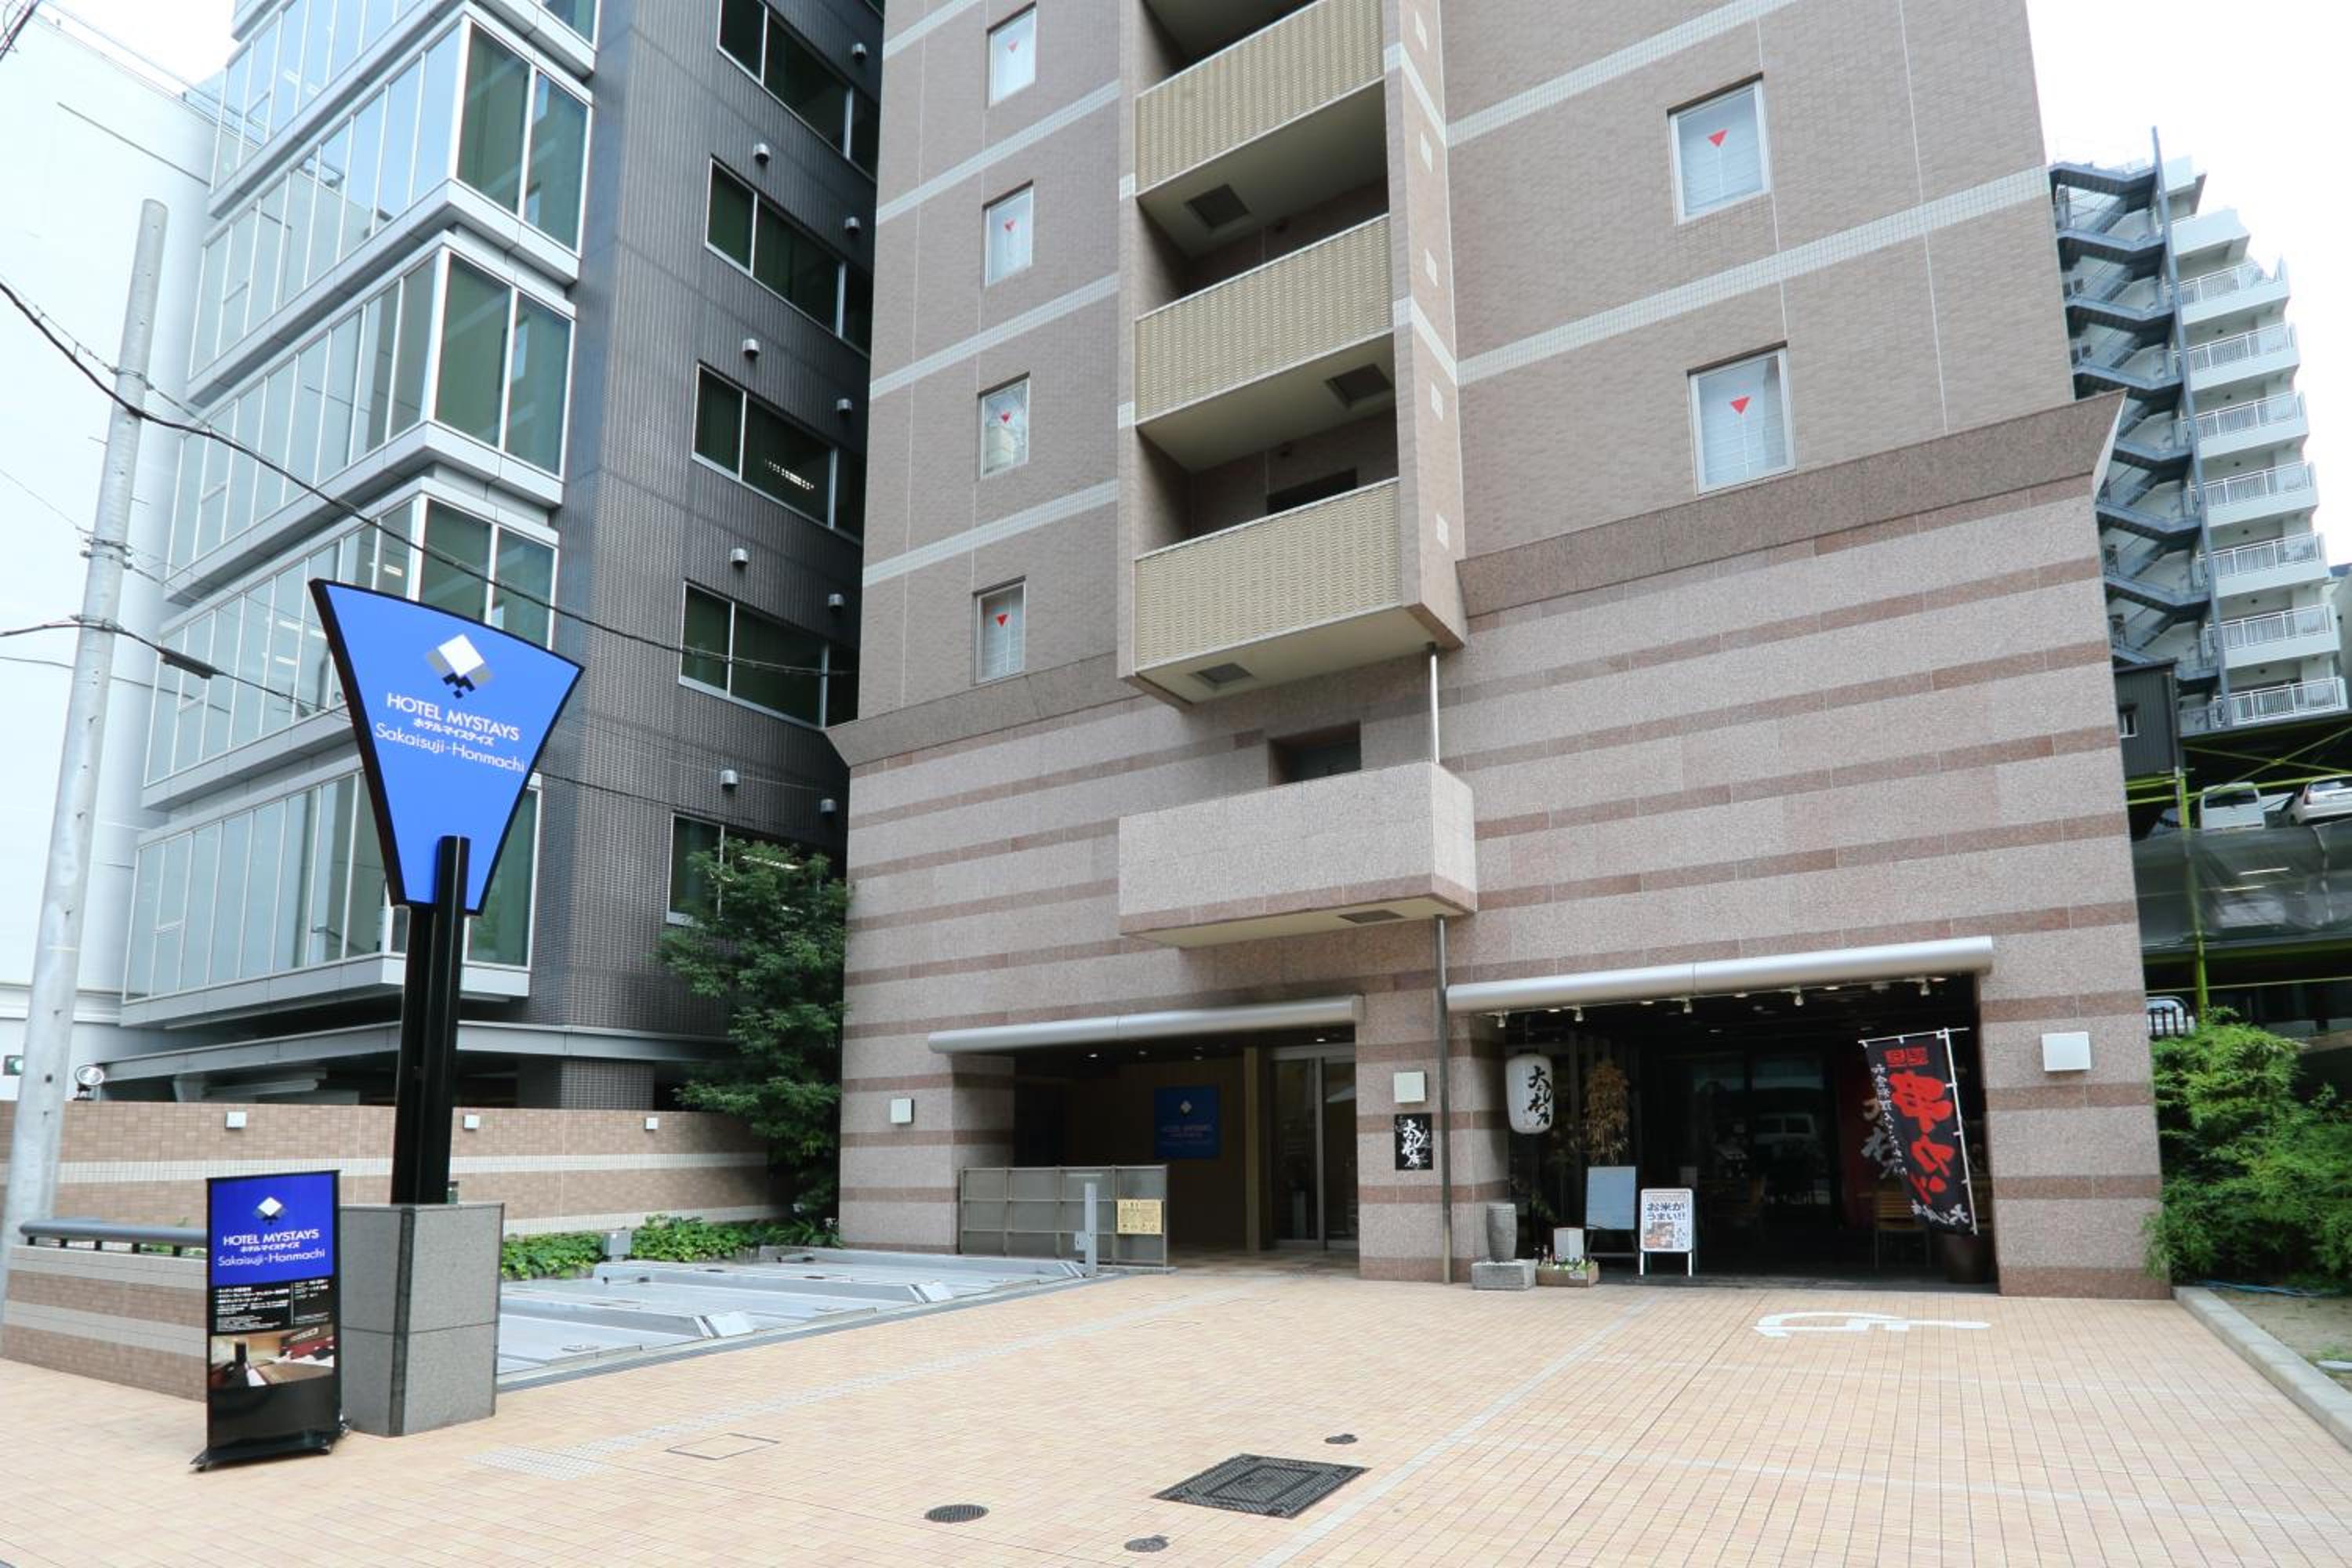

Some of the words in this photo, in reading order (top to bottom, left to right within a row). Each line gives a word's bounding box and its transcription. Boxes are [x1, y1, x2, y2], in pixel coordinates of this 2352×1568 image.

[387, 692, 442, 720] HOTEL
[447, 709, 520, 741] MYSTAYS
[376, 722, 525, 773] Sakaisuji-Honmachi
[223, 1234, 260, 1246] HOTEL
[263, 1229, 319, 1243] MYSTAYS
[218, 1248, 325, 1267] Sakaisuji-Honmachi
